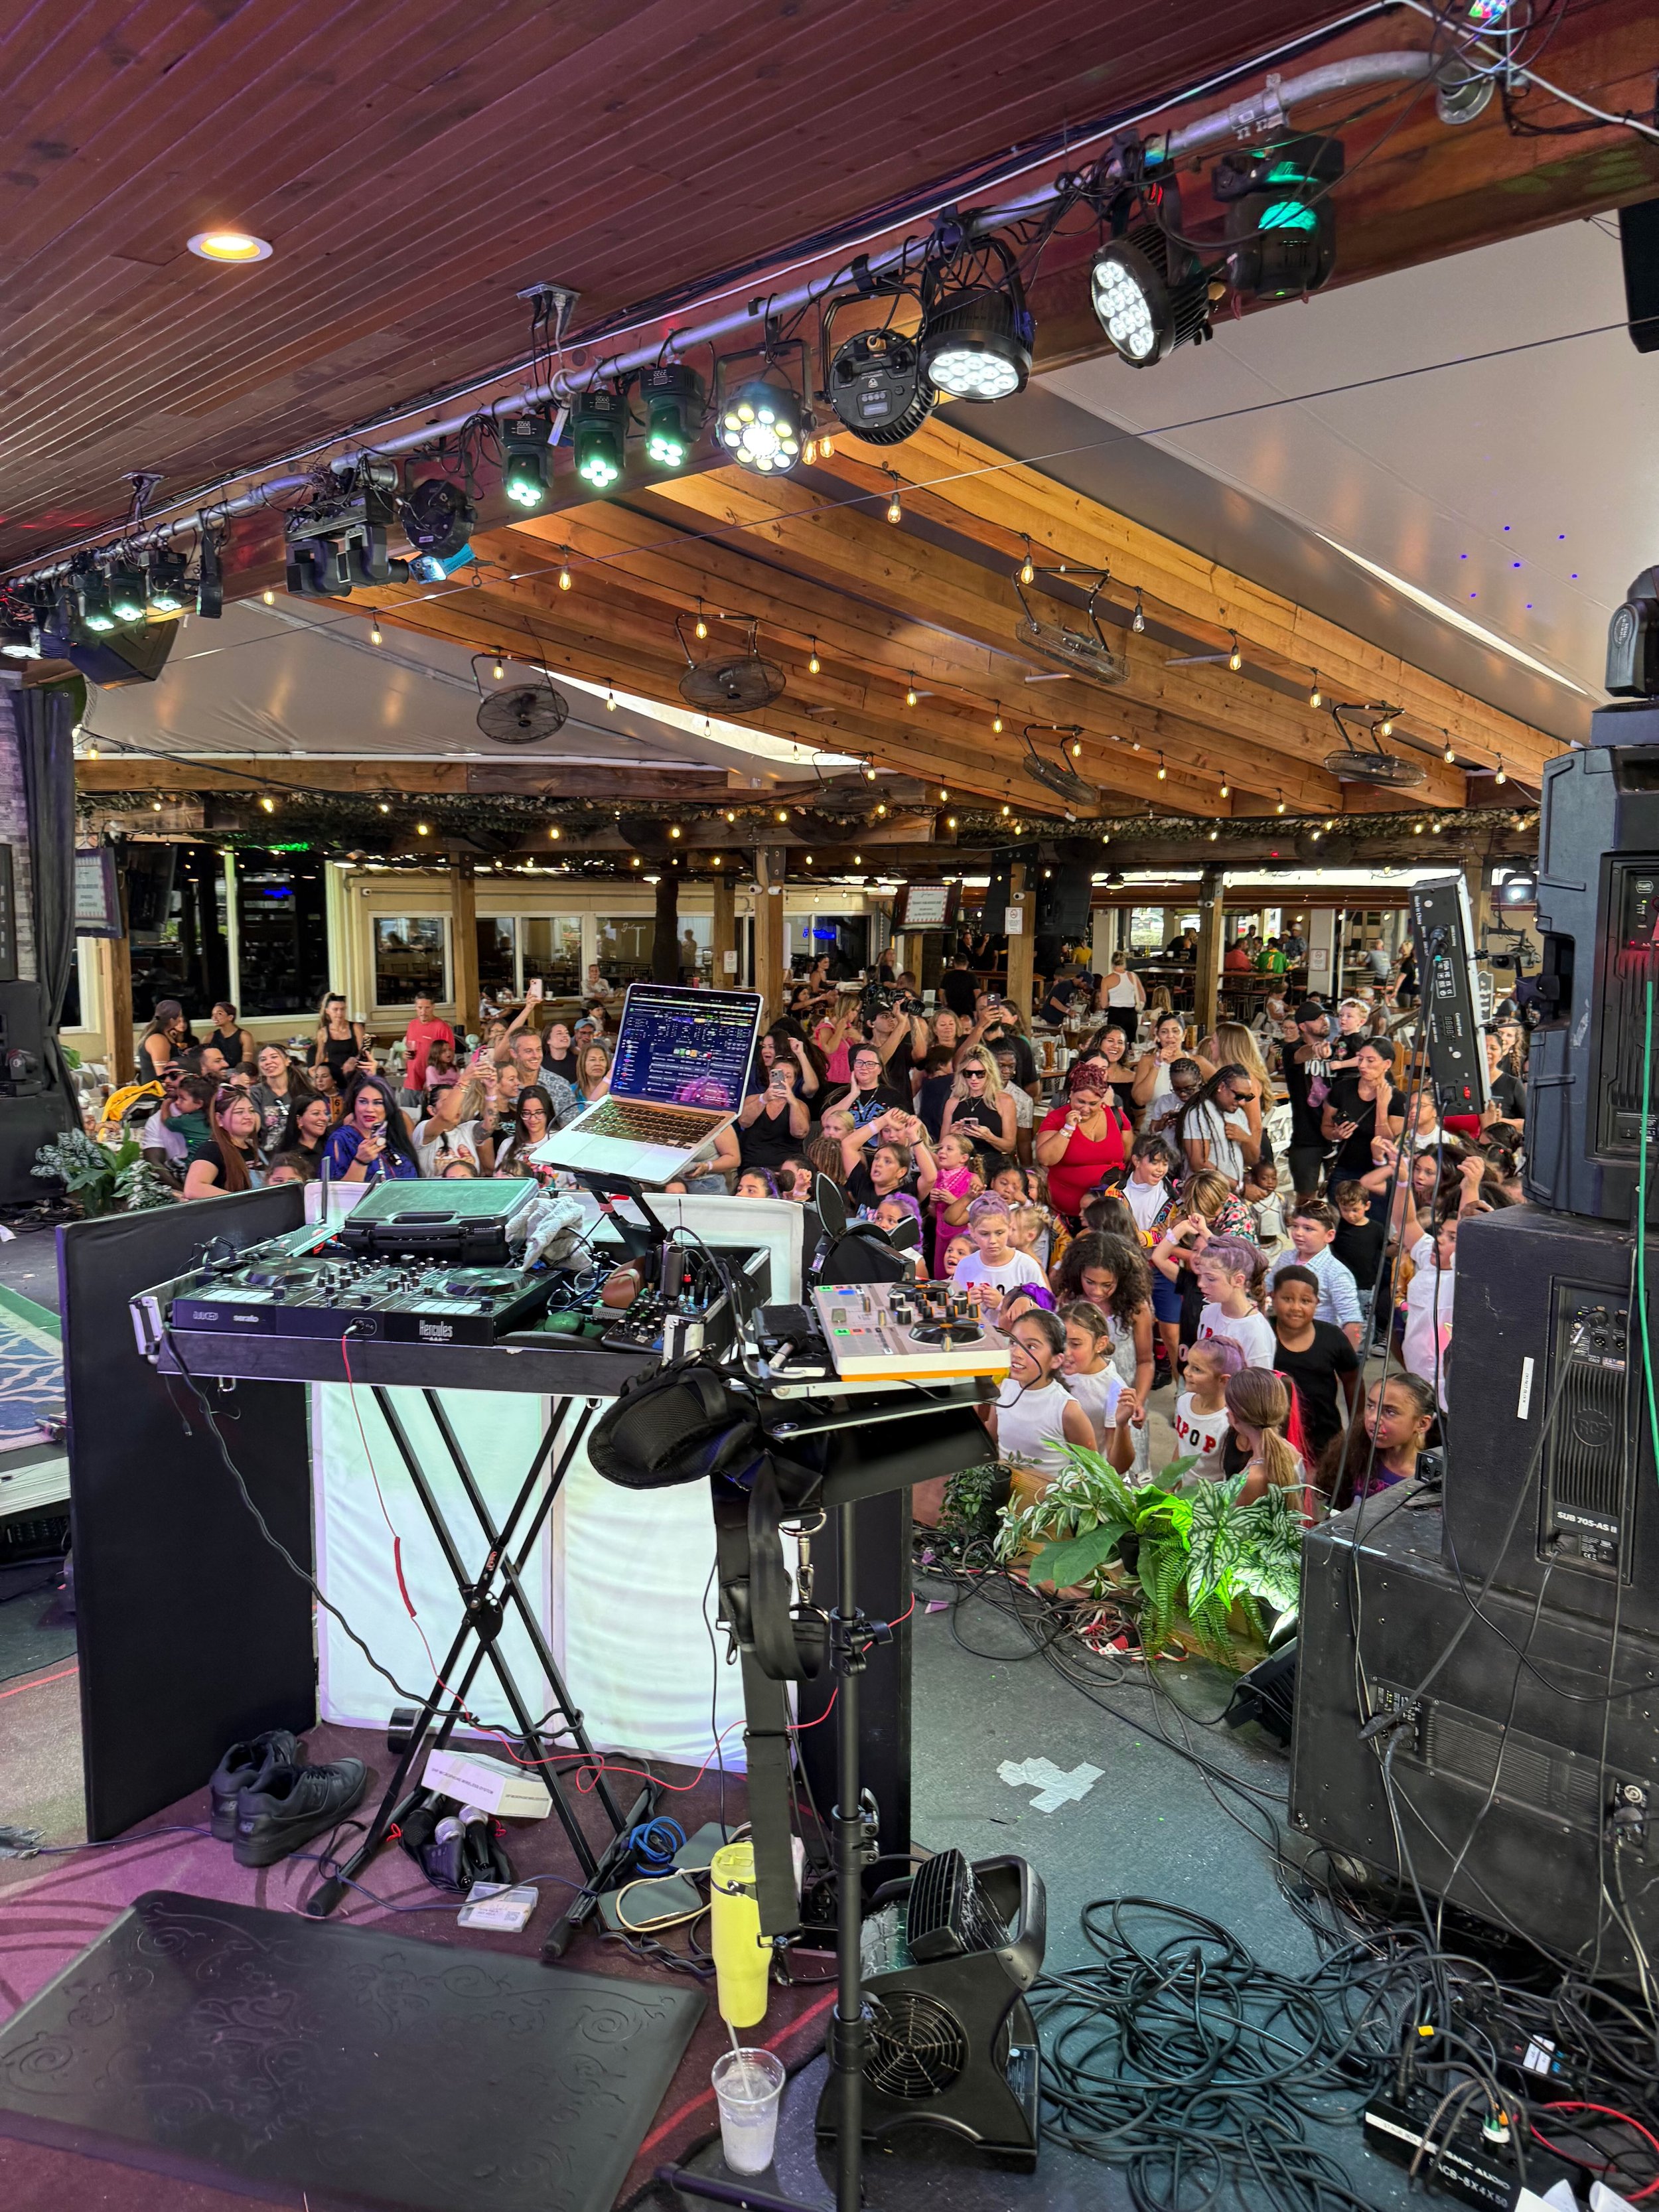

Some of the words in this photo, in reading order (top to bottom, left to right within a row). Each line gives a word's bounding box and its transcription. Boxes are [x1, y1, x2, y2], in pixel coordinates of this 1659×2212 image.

[419, 1319, 453, 1337] Hercules
[1579, 1418, 1608, 1437] RCF
[1557, 1511, 1576, 1522] SUB
[1577, 1516, 1609, 1531] 705-AS
[1475, 2167, 1511, 2191] AUDIO
